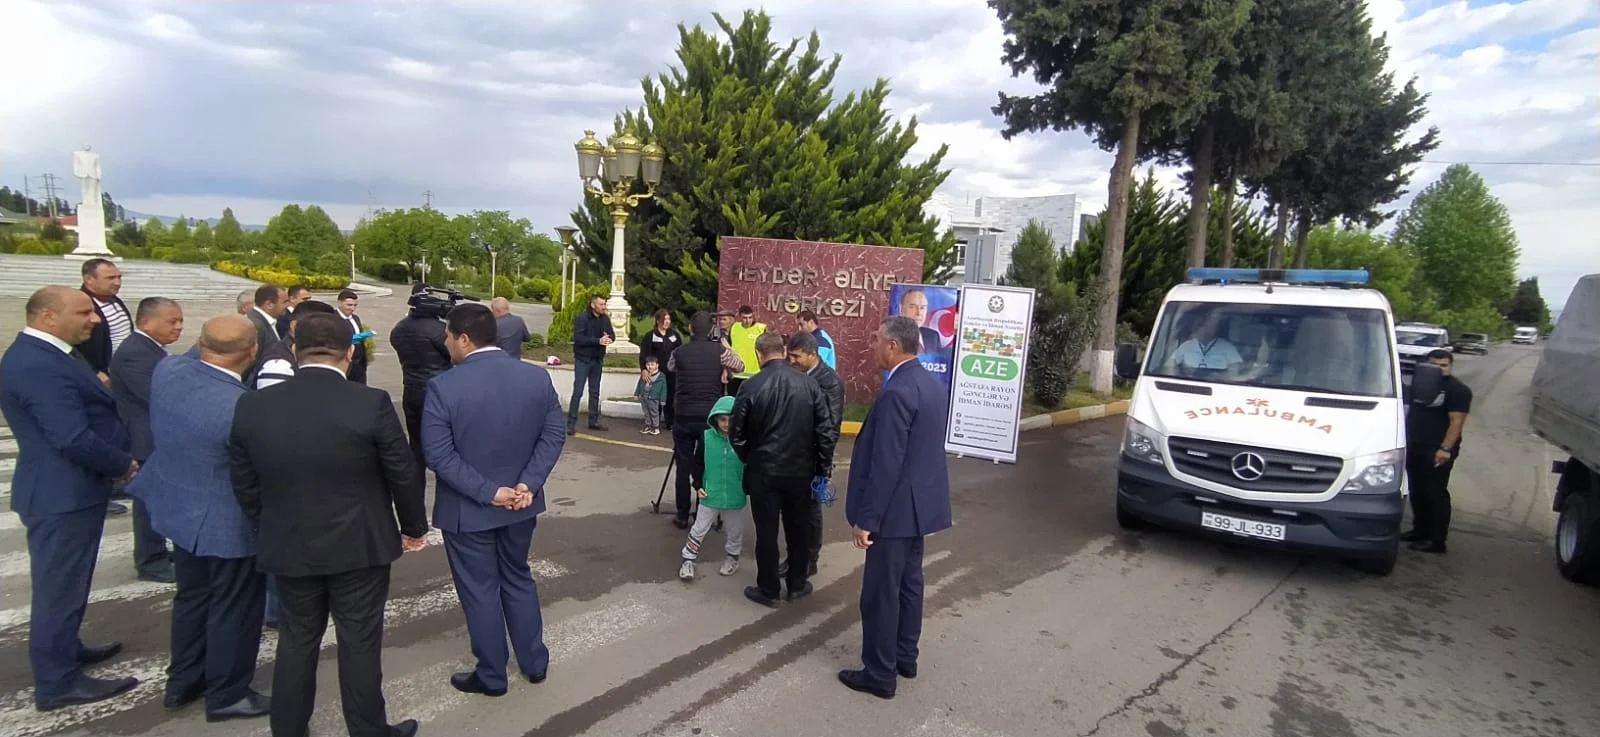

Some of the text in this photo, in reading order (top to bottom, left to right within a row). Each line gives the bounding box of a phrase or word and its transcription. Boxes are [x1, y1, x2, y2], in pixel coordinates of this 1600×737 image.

[732, 263, 819, 287] HEYDƏR
[766, 293, 866, 318] MƏRKƏZİ
[970, 359, 1008, 376] AZE
[990, 386, 1016, 394] RAYON
[1214, 516, 1283, 538] 99-JL-933
